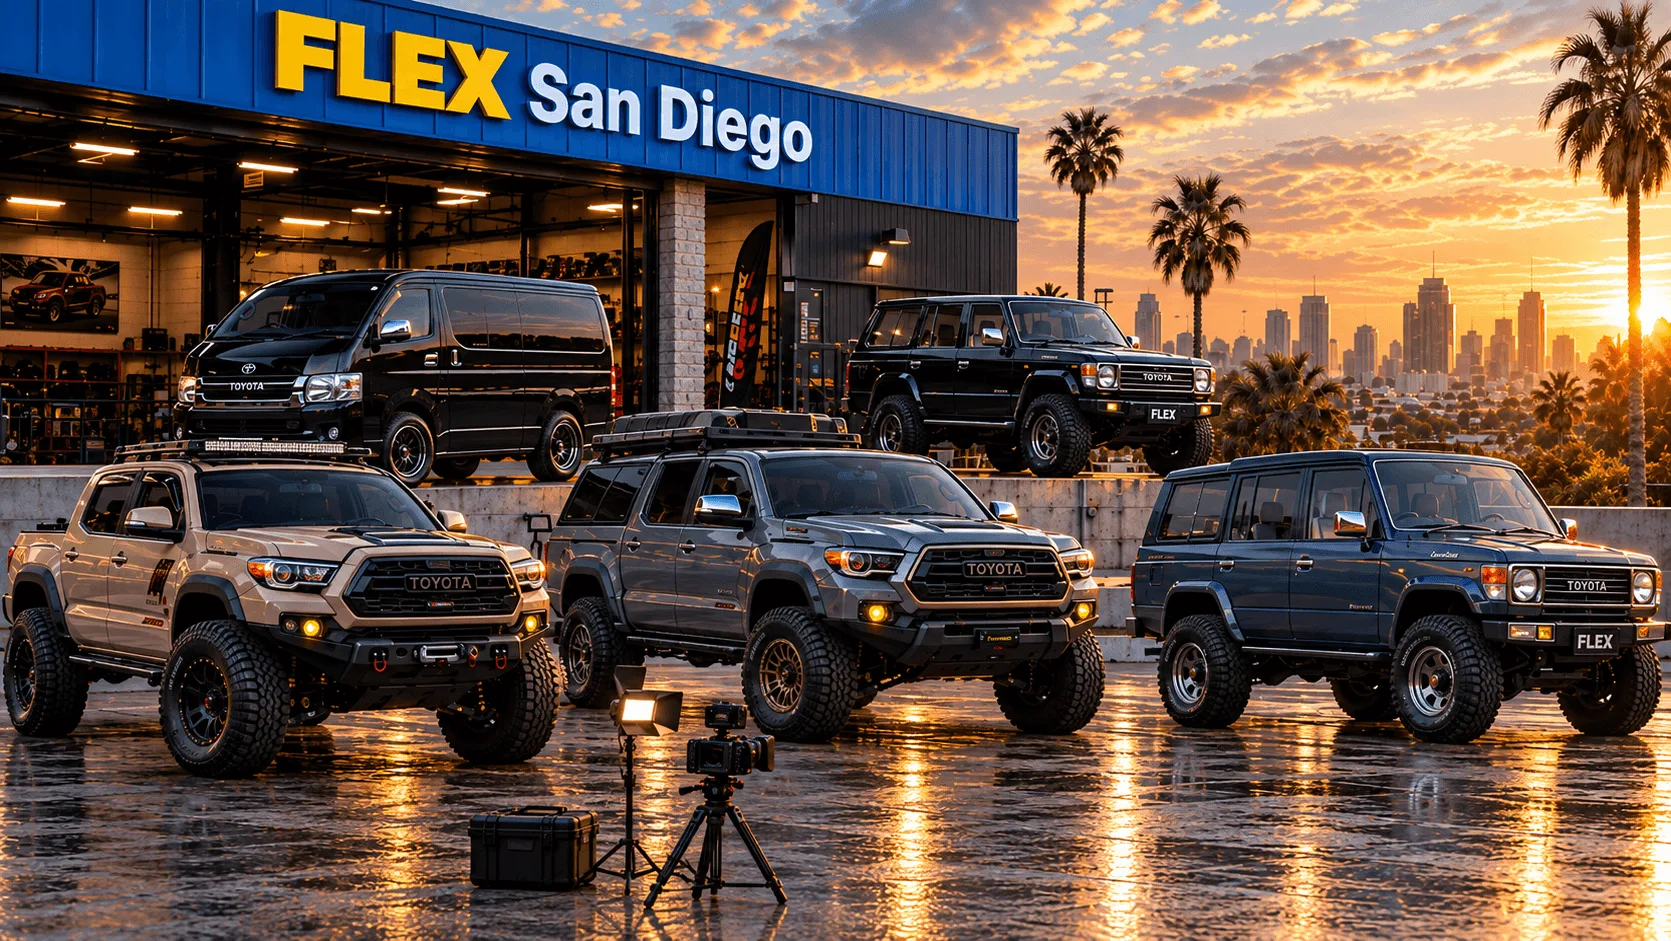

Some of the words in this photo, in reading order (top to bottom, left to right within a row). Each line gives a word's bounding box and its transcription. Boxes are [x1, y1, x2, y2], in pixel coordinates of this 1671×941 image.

[274, 10, 511, 120] FLEX
[528, 62, 641, 136] San
[657, 83, 814, 171] Diego
[1142, 373, 1172, 382] TOYOTA
[229, 381, 264, 391] TOYOTA
[1151, 408, 1176, 420] FLEX
[967, 563, 1022, 575] TOYOTA
[409, 576, 471, 589] TOYOTA
[1567, 580, 1607, 591] TOYOTA
[1577, 634, 1613, 649] FLEX
